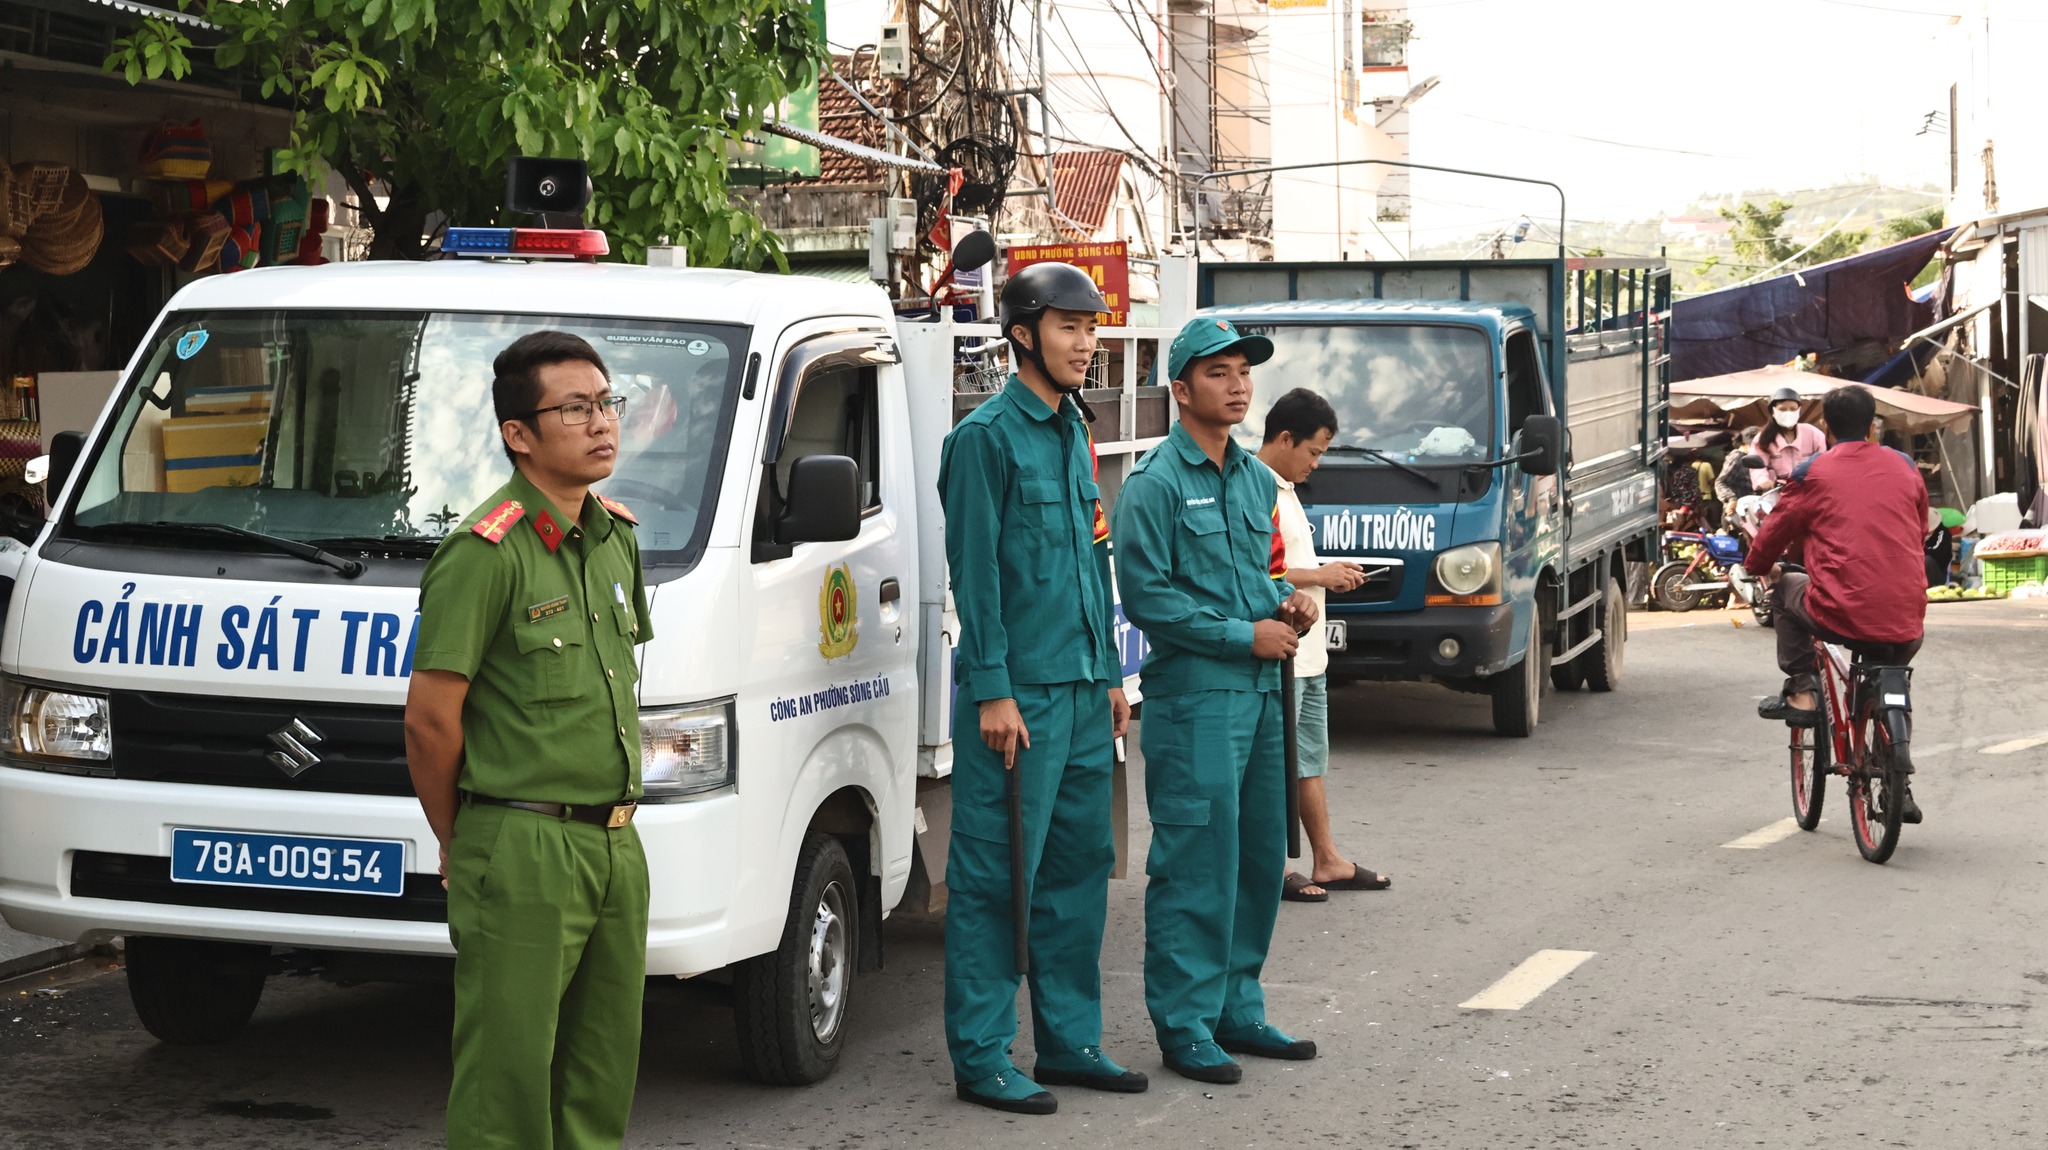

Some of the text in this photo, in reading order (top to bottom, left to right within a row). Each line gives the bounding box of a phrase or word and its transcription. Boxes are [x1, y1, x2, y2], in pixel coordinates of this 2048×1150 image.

[1014, 249, 1037, 260] UBND
[1040, 246, 1074, 259] PHƯỜNG
[1078, 246, 1101, 257] SÔNG
[1111, 310, 1123, 325] XE
[1322, 506, 1436, 551] MÔI TRƯỜNG
[73, 581, 203, 667] CẢNH
[216, 595, 320, 672] SÁT
[770, 696, 798, 722] CÔNG
[799, 694, 813, 716] AN
[813, 684, 849, 712] PHƯỜNG
[849, 679, 872, 704] SÔNG
[192, 839, 382, 884] 78A-009.54
